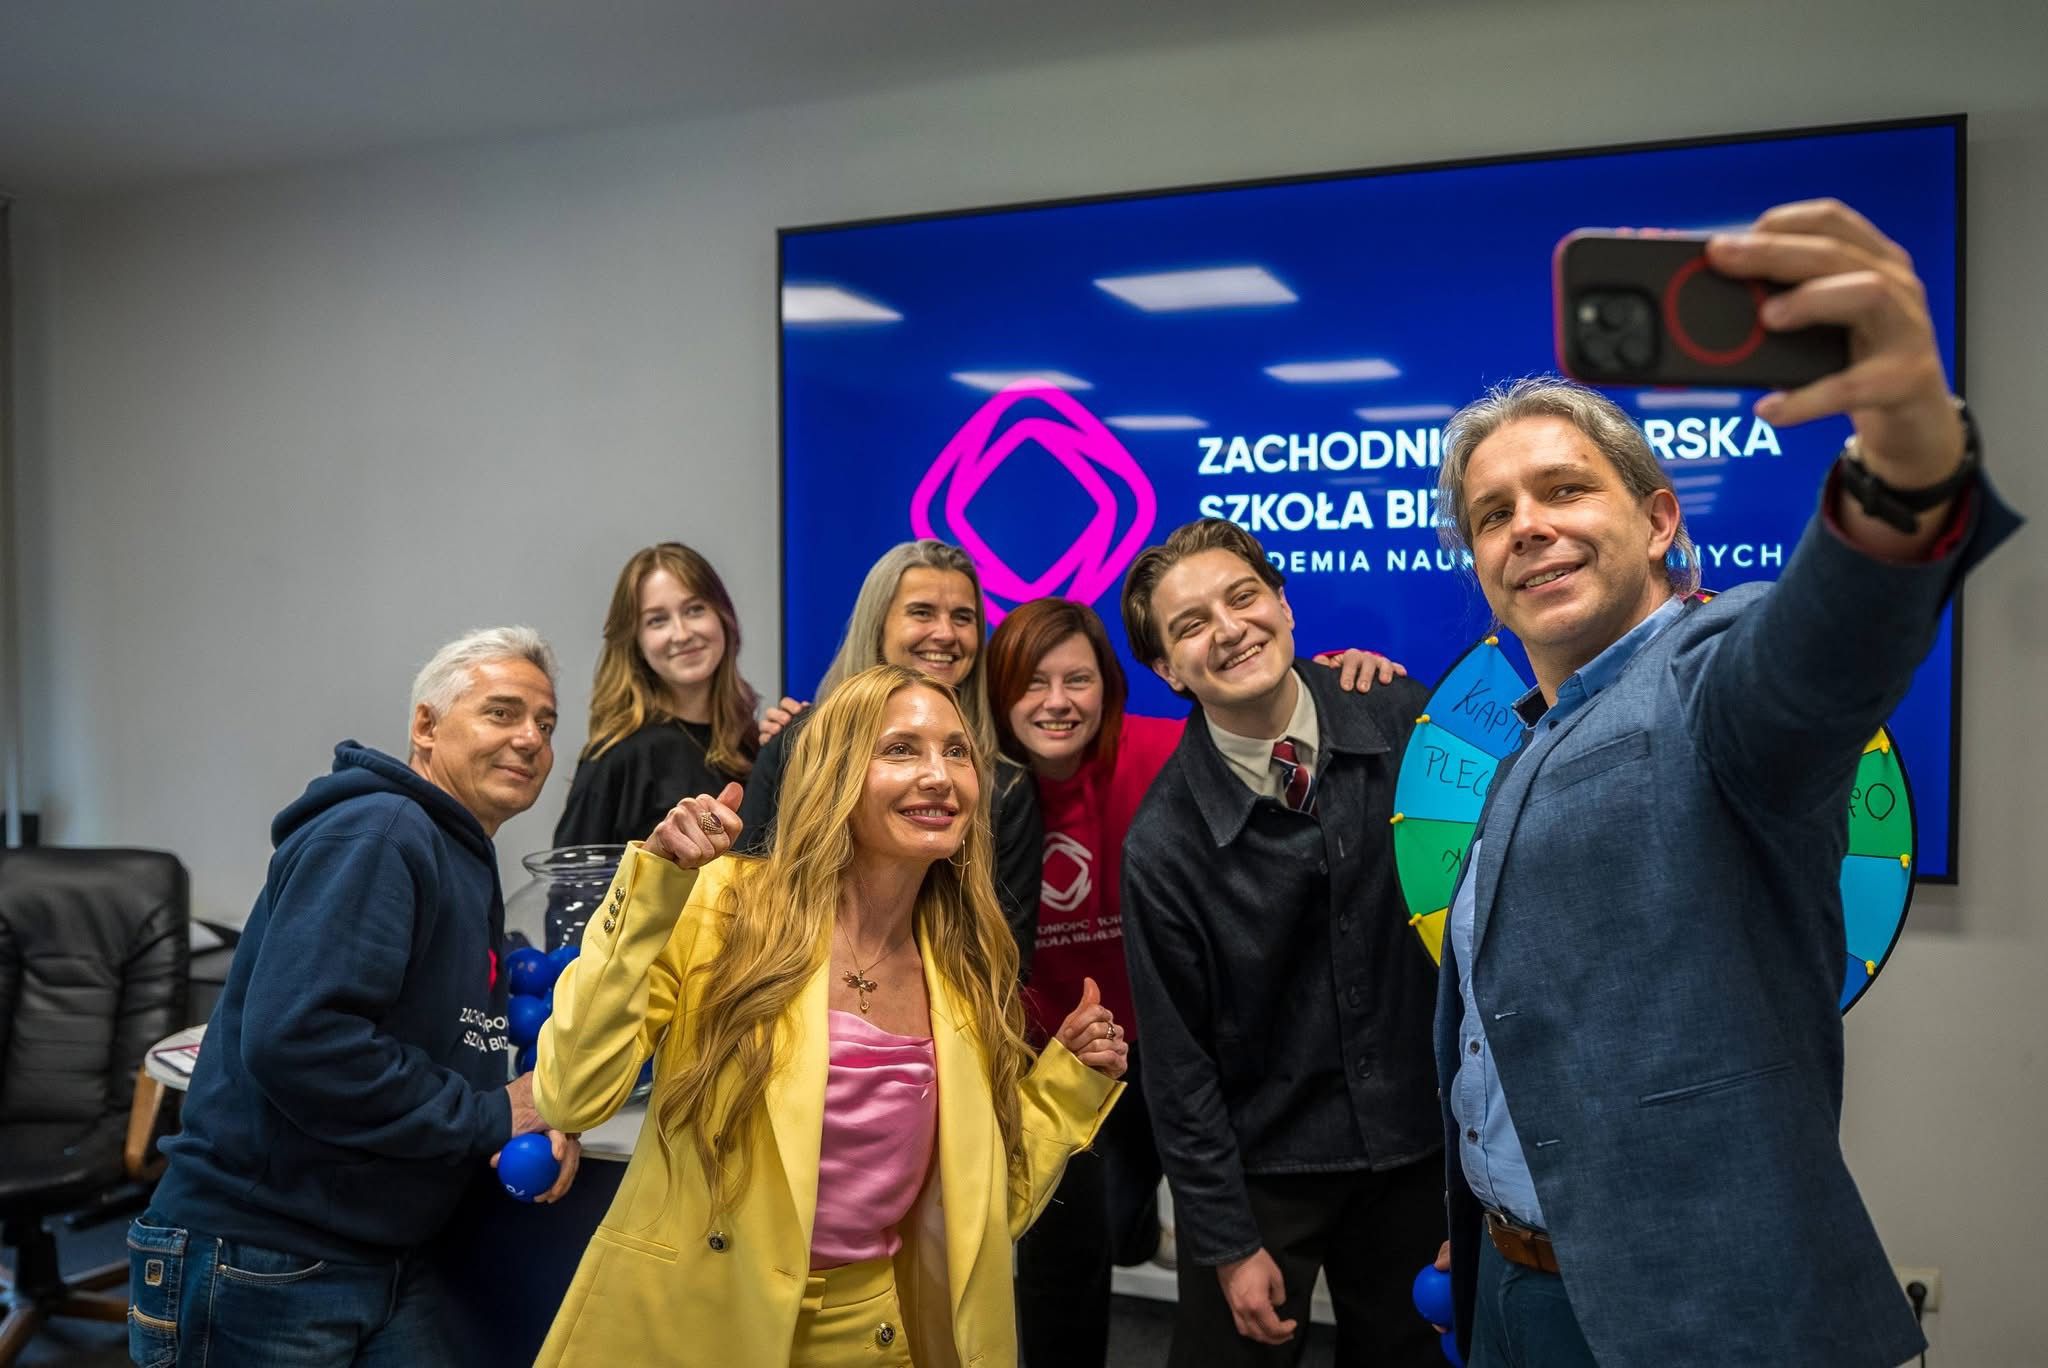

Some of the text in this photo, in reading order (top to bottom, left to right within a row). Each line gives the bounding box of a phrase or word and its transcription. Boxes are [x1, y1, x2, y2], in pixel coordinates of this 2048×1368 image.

[1199, 490, 1374, 532] SZKOŁA
[1266, 549, 1371, 573] DEMIA
[1452, 678, 1523, 751] KAPT
[1423, 745, 1491, 797] PLEC
